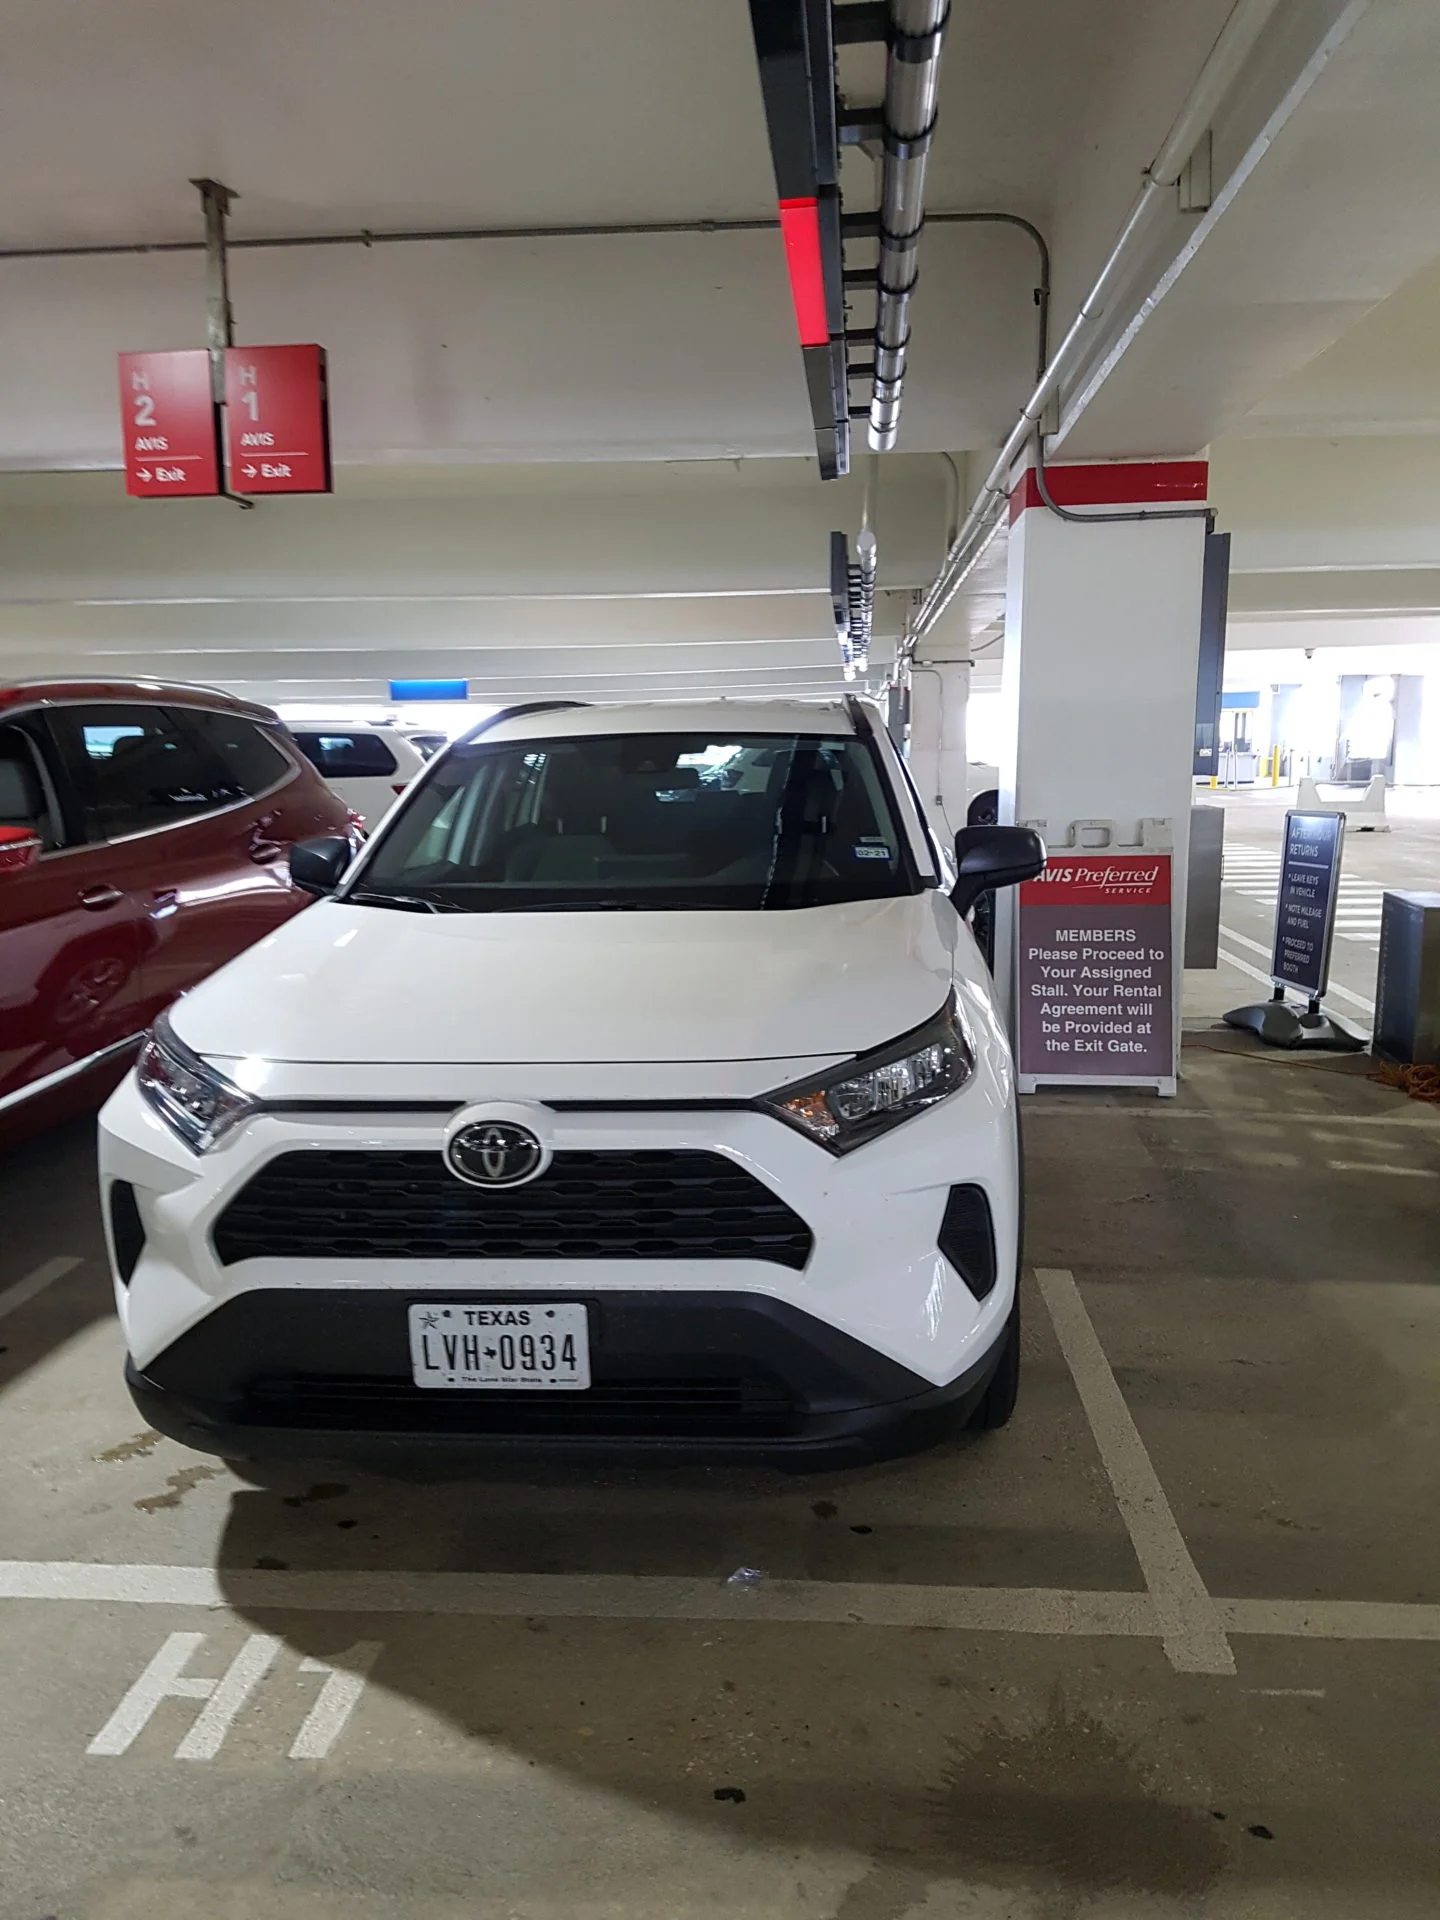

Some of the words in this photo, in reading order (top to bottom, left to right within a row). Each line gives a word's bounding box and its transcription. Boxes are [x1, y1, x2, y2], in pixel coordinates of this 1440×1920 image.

[131, 371, 150, 391] H
[239, 365, 257, 386] H
[134, 395, 157, 427] 2
[241, 391, 259, 422] 1
[135, 436, 169, 451] AVIS
[240, 432, 275, 447] AVIS
[156, 466, 187, 482] Exit
[261, 463, 293, 478] Exit
[1289, 843, 1319, 858] RETURNS
[1033, 868, 1074, 882] AVIS
[1074, 866, 1159, 889] Preferred
[1291, 874, 1306, 884] LEAVE
[1306, 875, 1319, 886] KEYS
[1055, 929, 1136, 942] MEMBERS
[1029, 948, 1078, 960] Please
[1082, 948, 1145, 961] Proceed
[1149, 949, 1164, 961] to
[1040, 966, 1076, 979] Your
[1081, 966, 1152, 981] Assigned
[1031, 984, 1068, 997] Stall.
[1073, 984, 1109, 997] Your
[1113, 984, 1162, 997] Rental
[1040, 1002, 1123, 1018] Agreement
[1127, 1002, 1153, 1016] will
[1042, 1021, 1060, 1033] be
[1065, 1021, 1132, 1034] Provided
[1137, 1022, 1151, 1034] at
[1046, 1039, 1070, 1052] the
[1074, 1040, 1103, 1052] Exit
[1107, 1040, 1148, 1053] Gate.
[464, 1310, 531, 1326] TEXAS
[85, 1632, 385, 1760] H1
